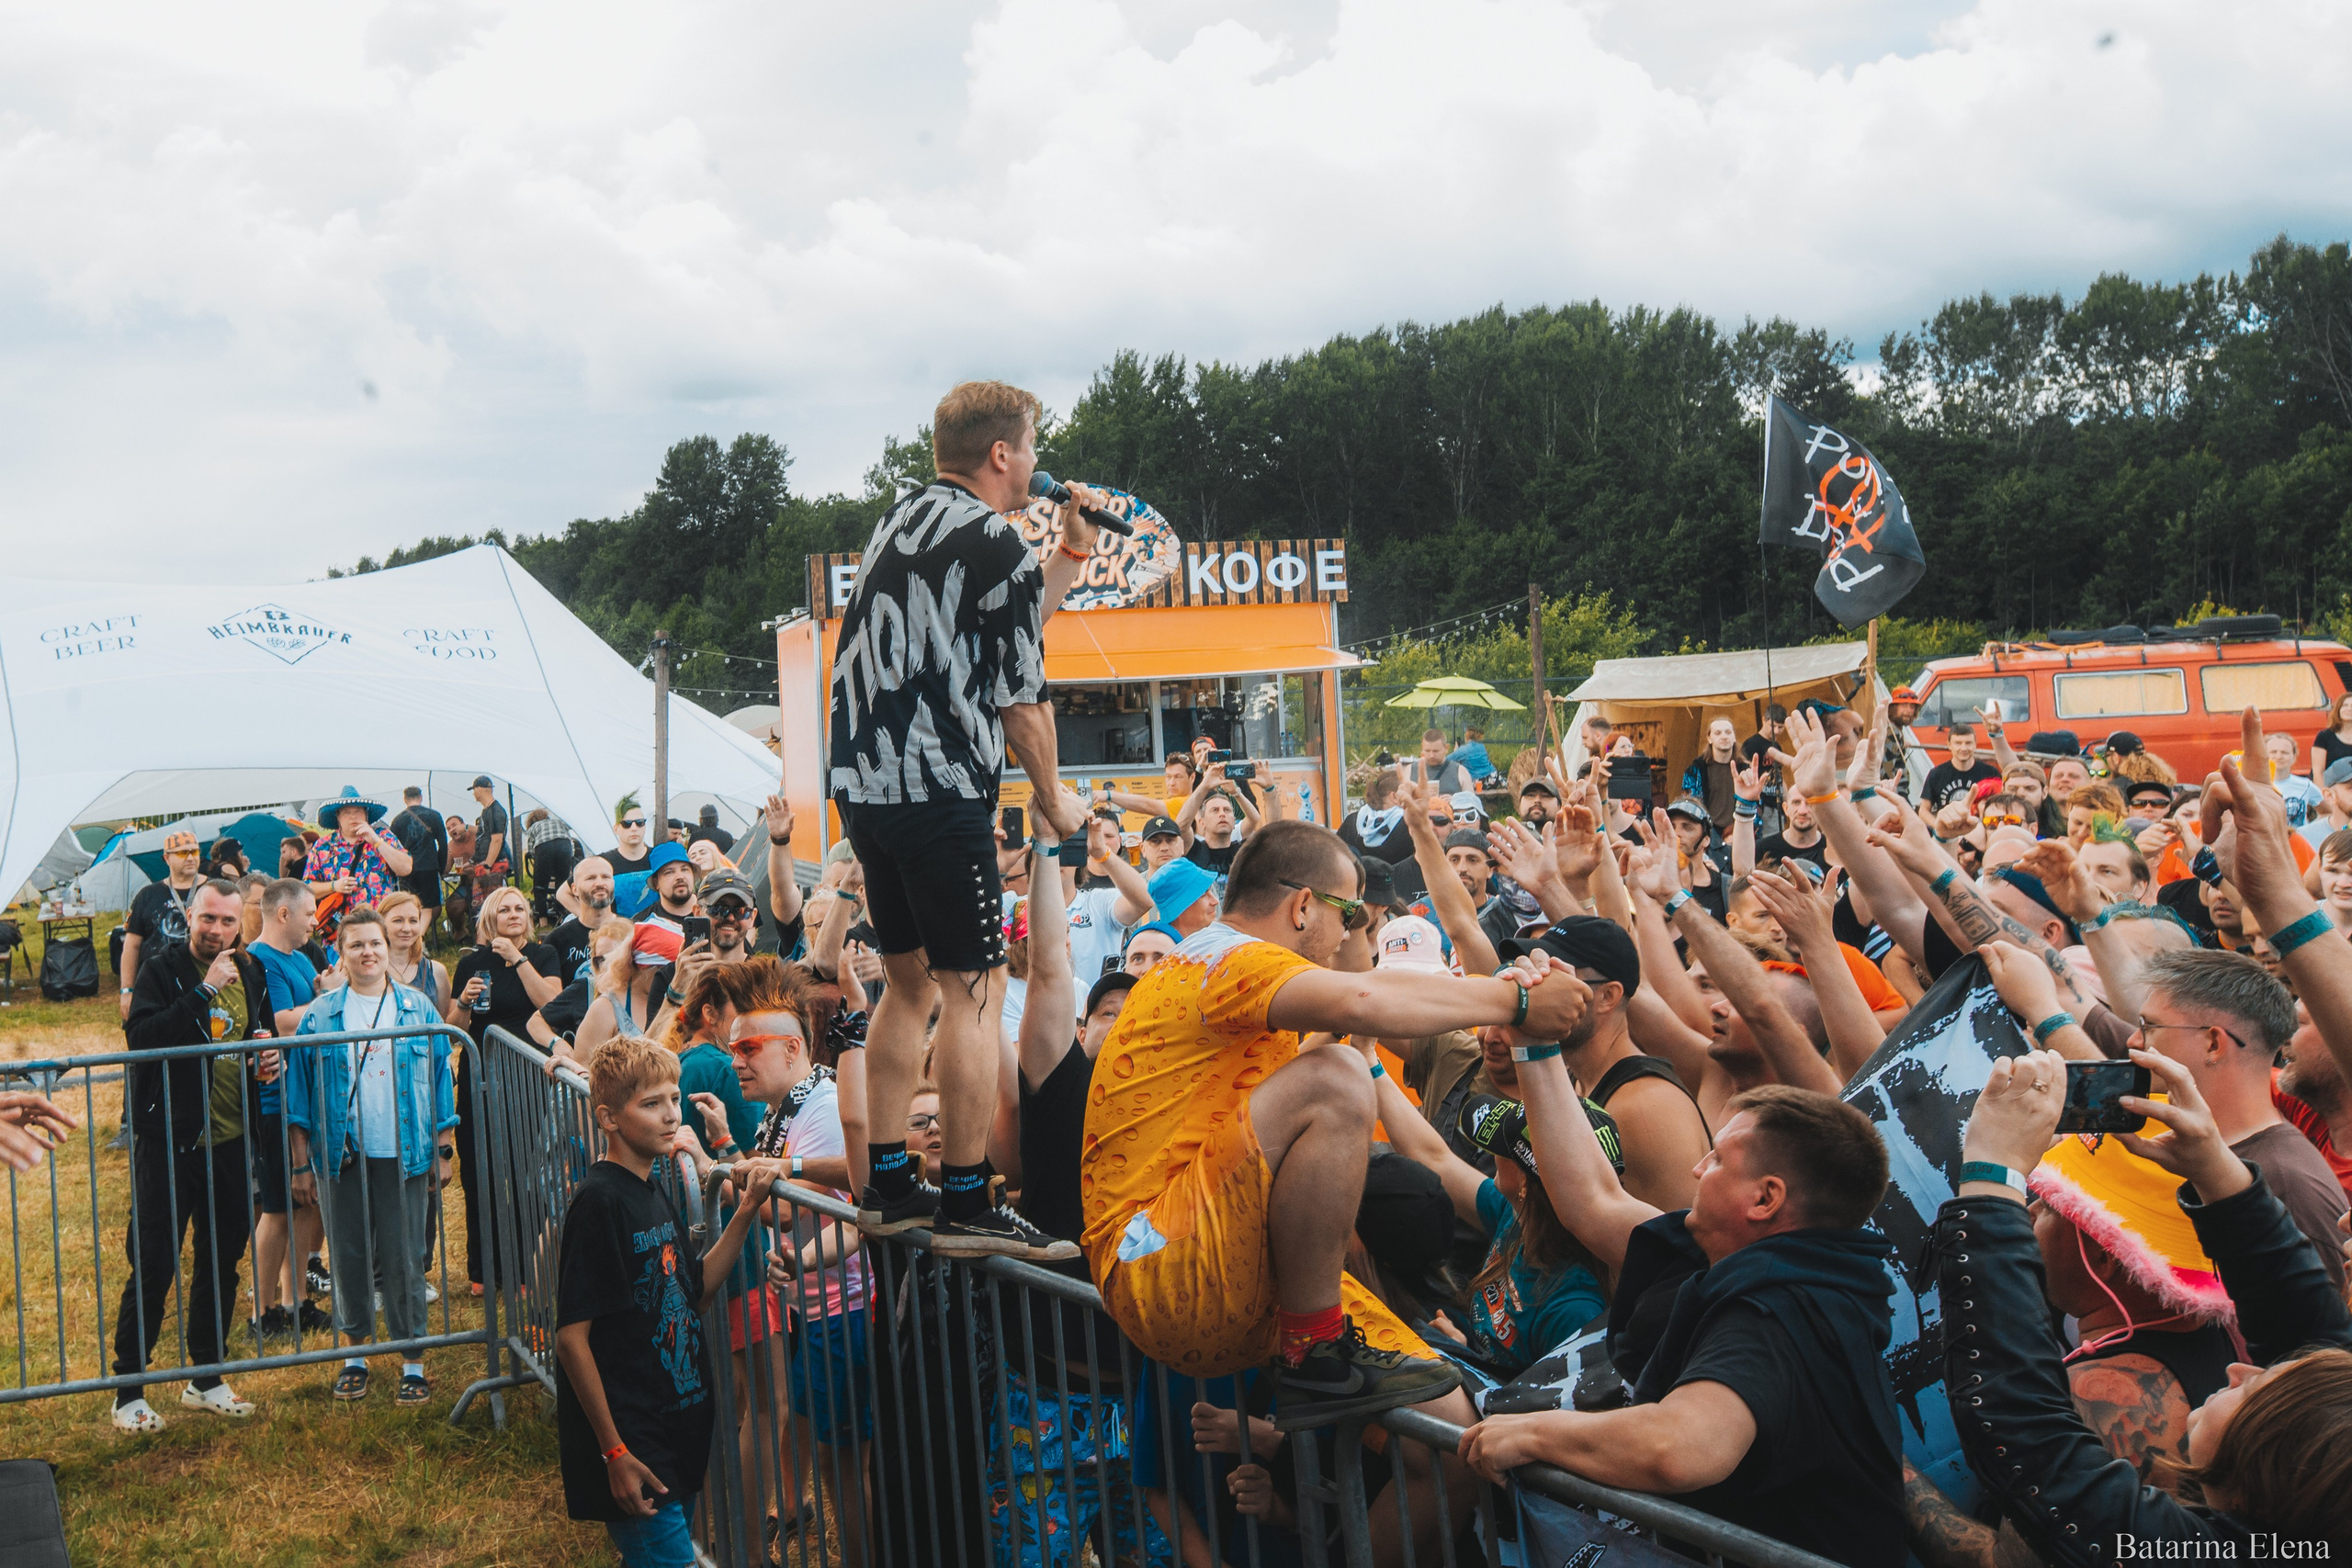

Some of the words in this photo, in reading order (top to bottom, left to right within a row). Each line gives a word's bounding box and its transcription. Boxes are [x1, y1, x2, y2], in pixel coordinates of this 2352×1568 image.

[1023, 496, 1128, 540] SUR
[1039, 530, 1120, 561] HO
[1188, 550, 1347, 595] КОФЕ
[40, 614, 142, 643] CRAFT
[402, 628, 494, 642] CRAFT
[55, 635, 138, 660] BEER
[413, 645, 496, 660] FOOD
[944, 1178, 985, 1192] МОЛОДОЙ
[949, 1174, 978, 1184] ВЕЧНО
